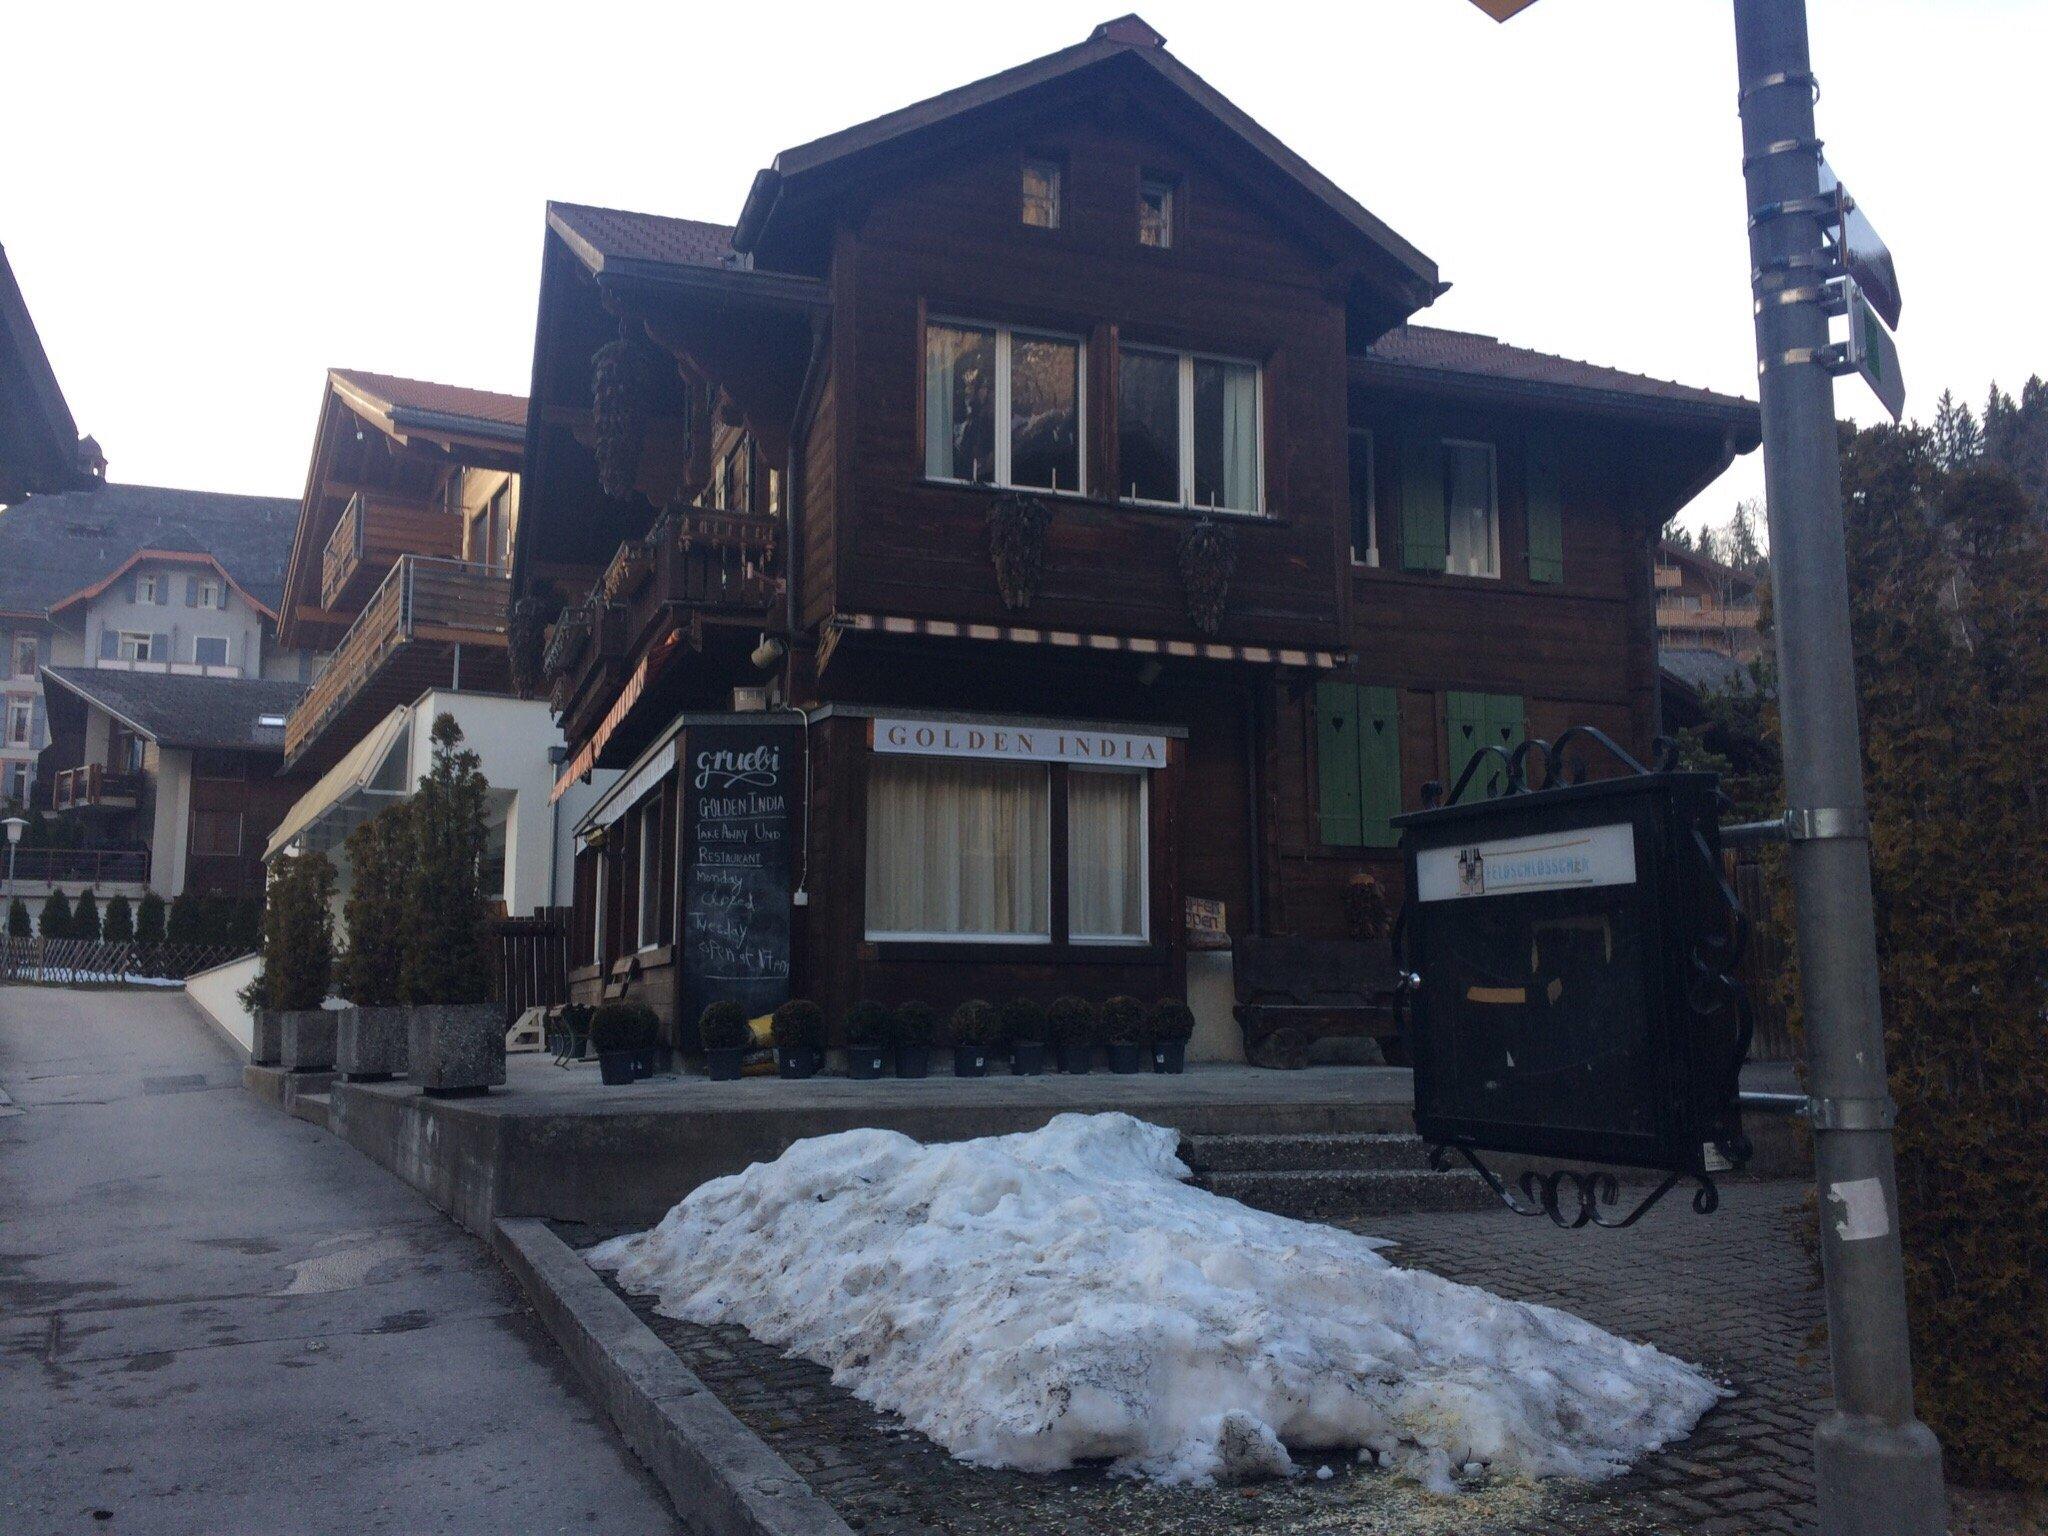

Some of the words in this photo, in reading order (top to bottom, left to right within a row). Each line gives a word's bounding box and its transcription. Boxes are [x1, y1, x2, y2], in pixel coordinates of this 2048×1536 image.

[888, 725, 1033, 754] GOLDEN
[1058, 735, 1157, 761] INDIA
[699, 797, 747, 819] GOLDEN
[747, 791, 785, 814] INDIA
